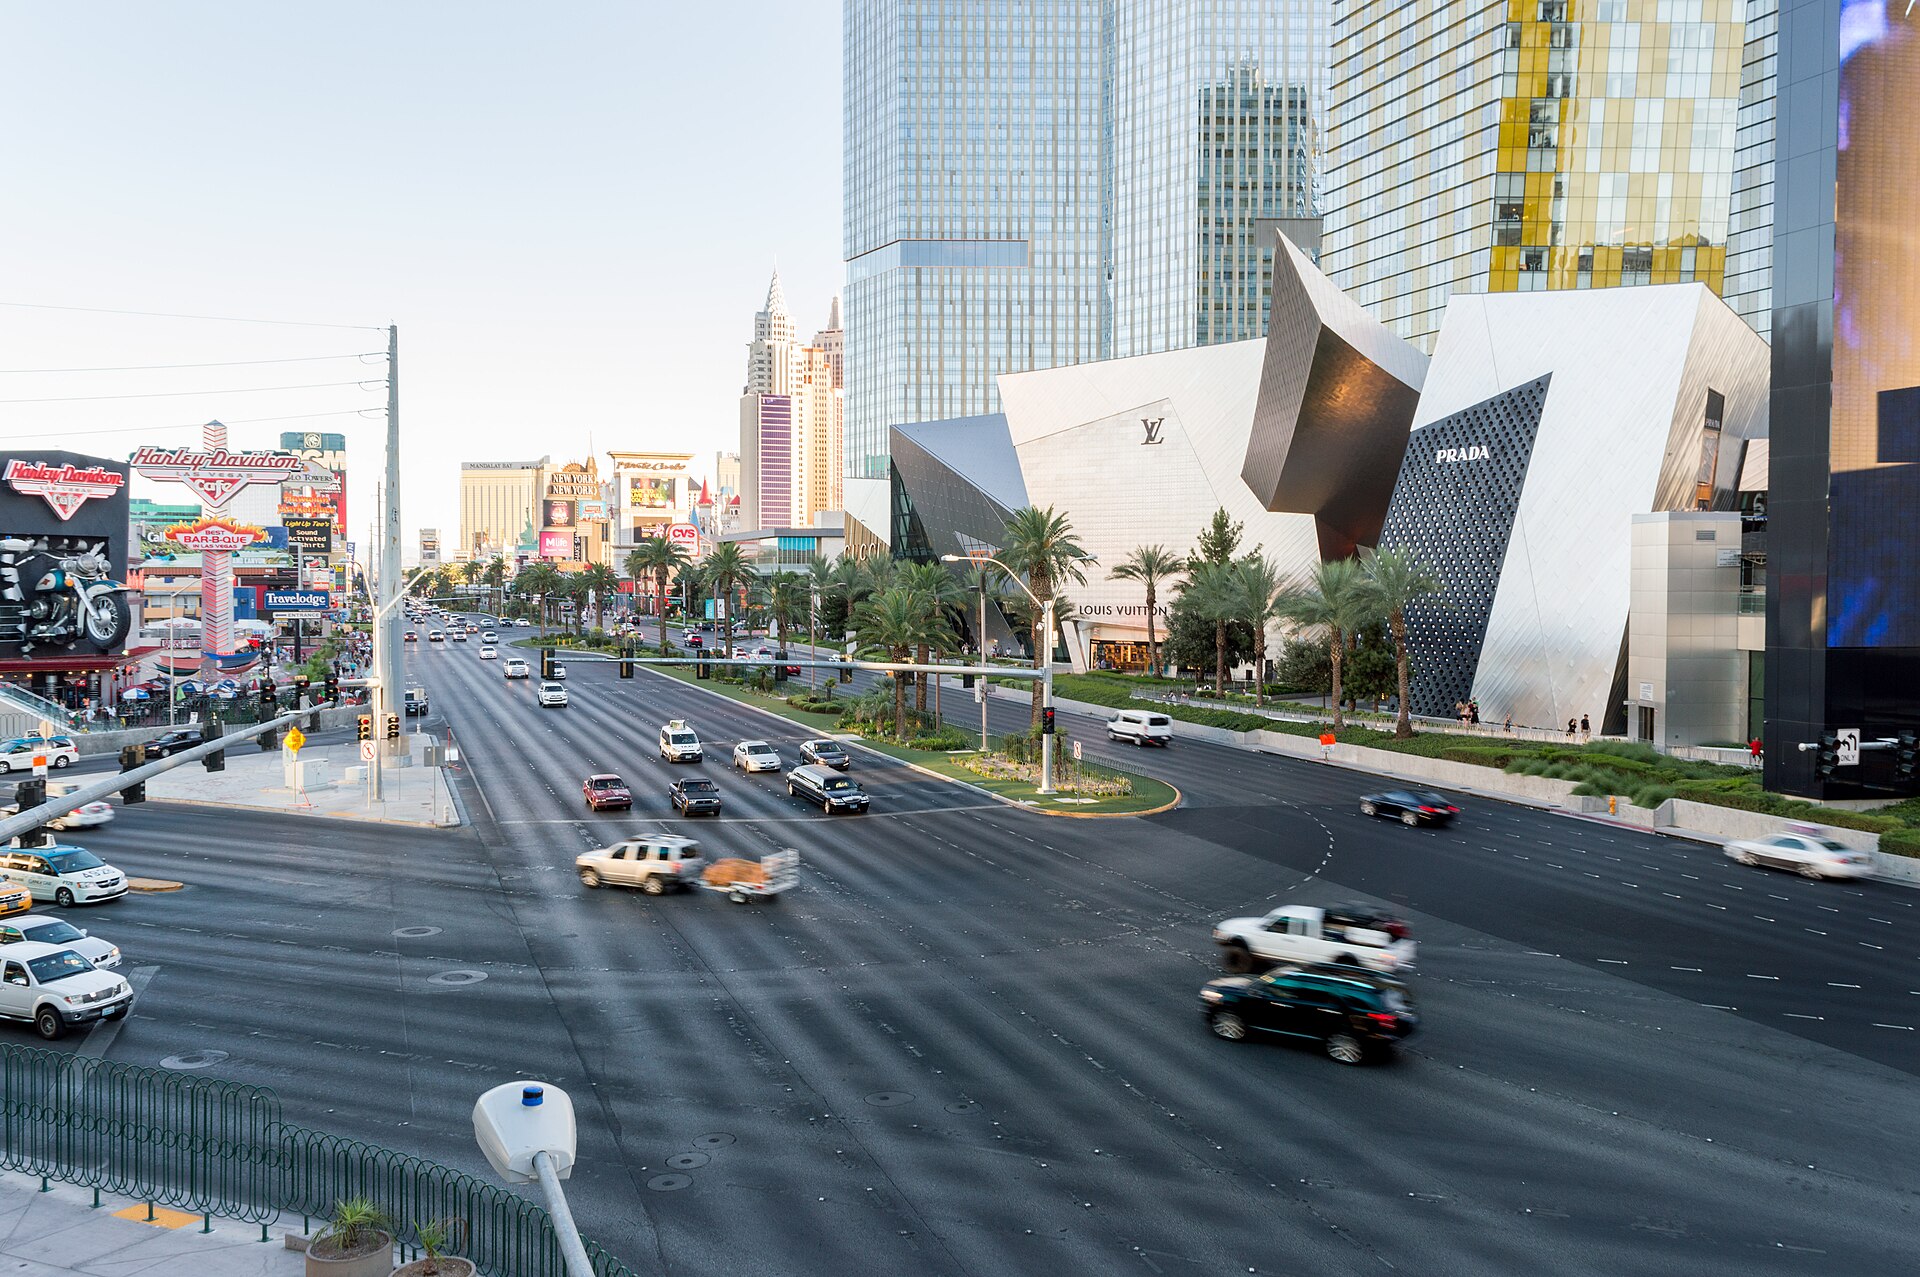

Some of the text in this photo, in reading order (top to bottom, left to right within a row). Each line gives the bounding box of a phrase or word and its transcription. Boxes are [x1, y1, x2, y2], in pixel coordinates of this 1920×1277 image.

[1435, 445, 1490, 464] PRADA
[303, 474, 333, 482] TOWERS
[553, 473, 594, 484] NEW YORK
[194, 479, 232, 498] Cafe
[553, 485, 594, 495] NEW YORK
[672, 529, 695, 538] CVS
[183, 536, 247, 544] BAR-B-QUE
[266, 593, 326, 607] Travelodge
[1079, 605, 1168, 616] LOUIS VUITTON
[1840, 754, 1856, 762] ONLY
